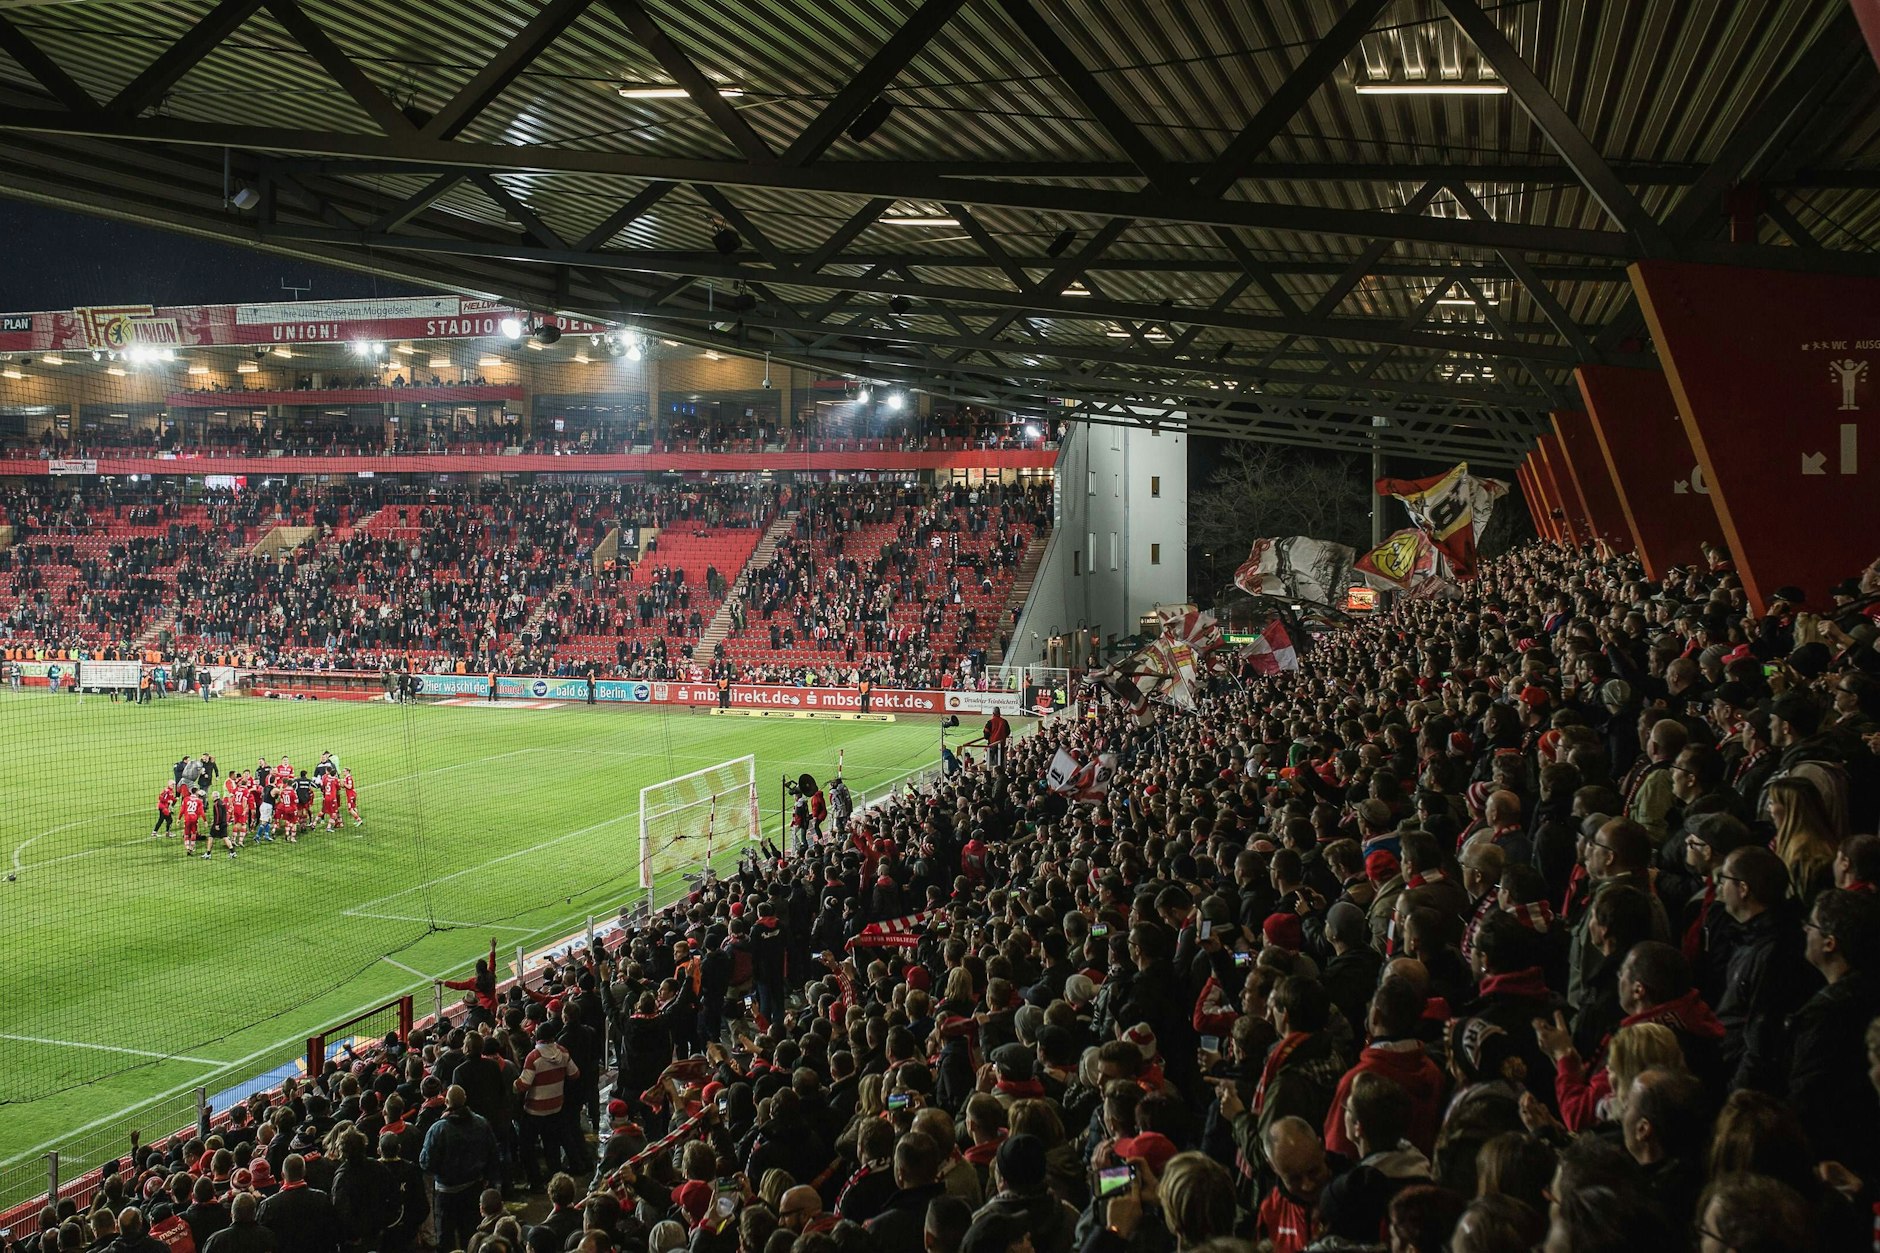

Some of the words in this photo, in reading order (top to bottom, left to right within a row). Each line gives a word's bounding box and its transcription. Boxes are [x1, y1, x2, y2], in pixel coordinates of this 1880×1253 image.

[464, 301, 504, 311] HELLWE
[4, 318, 29, 330] PLAN
[427, 318, 493, 336] STADIO
[133, 321, 178, 344] UNION
[273, 323, 338, 340] UNION!
[1831, 340, 1848, 350] WC
[425, 680, 442, 692] Hier
[444, 680, 473, 693] wäscht
[473, 682, 489, 693] der
[556, 685, 575, 697] bald
[577, 686, 588, 697] 6x
[600, 686, 626, 699] Berlin
[694, 687, 790, 704] mbsirekt.de
[822, 692, 923, 708] mbsdrekt.de
[187, 801, 198, 812] 28
